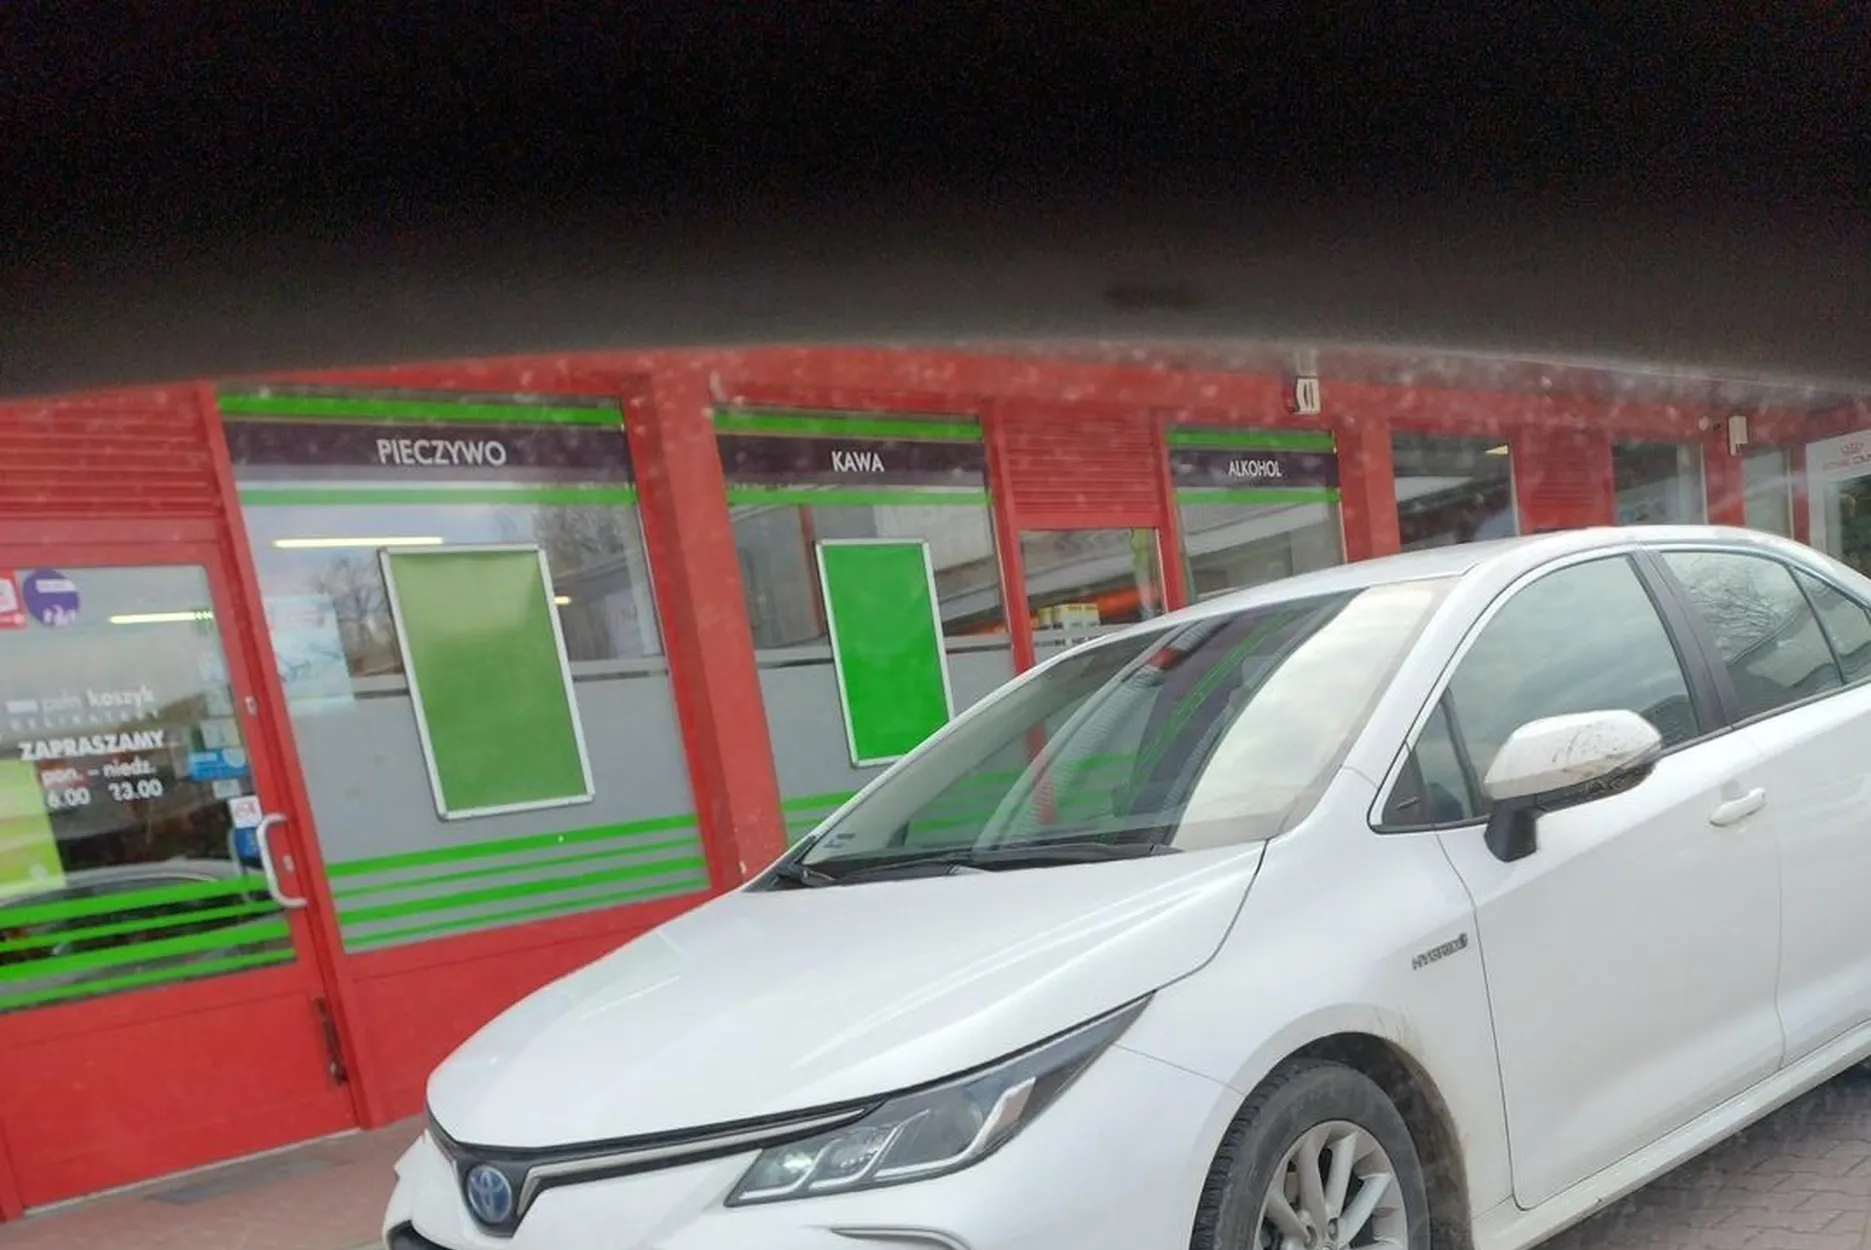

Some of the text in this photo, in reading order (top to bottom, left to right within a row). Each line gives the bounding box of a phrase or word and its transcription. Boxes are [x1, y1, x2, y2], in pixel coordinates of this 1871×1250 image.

[376, 438, 507, 466] PIECZYWO
[831, 450, 885, 472] KAWA
[1228, 459, 1282, 477] ALKOHOL
[17, 728, 165, 761] ZAPRASZAMY
